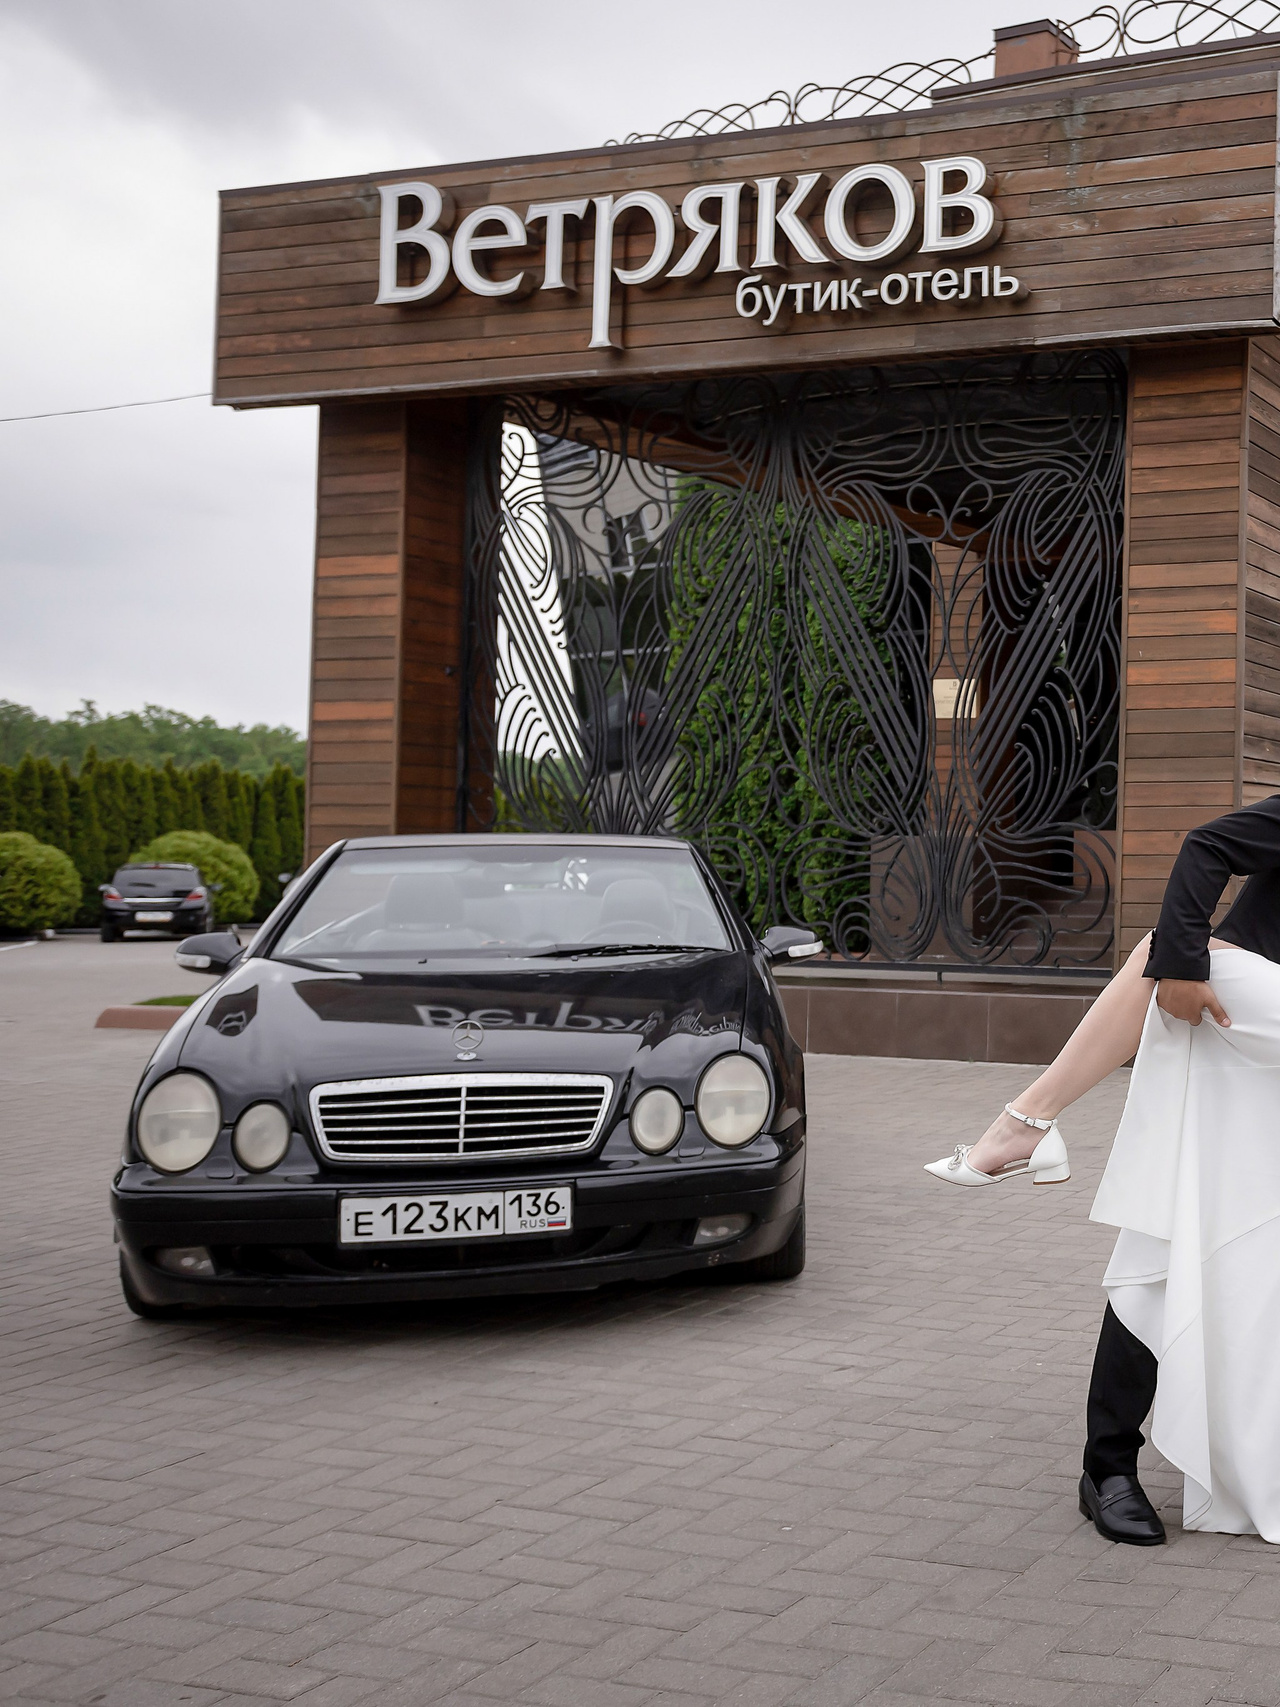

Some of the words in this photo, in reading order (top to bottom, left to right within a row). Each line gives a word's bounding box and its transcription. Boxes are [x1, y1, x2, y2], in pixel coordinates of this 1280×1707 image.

[735, 265, 1020, 326] бутик-отель
[508, 1191, 561, 1218] 136
[519, 1218, 546, 1230] RUS
